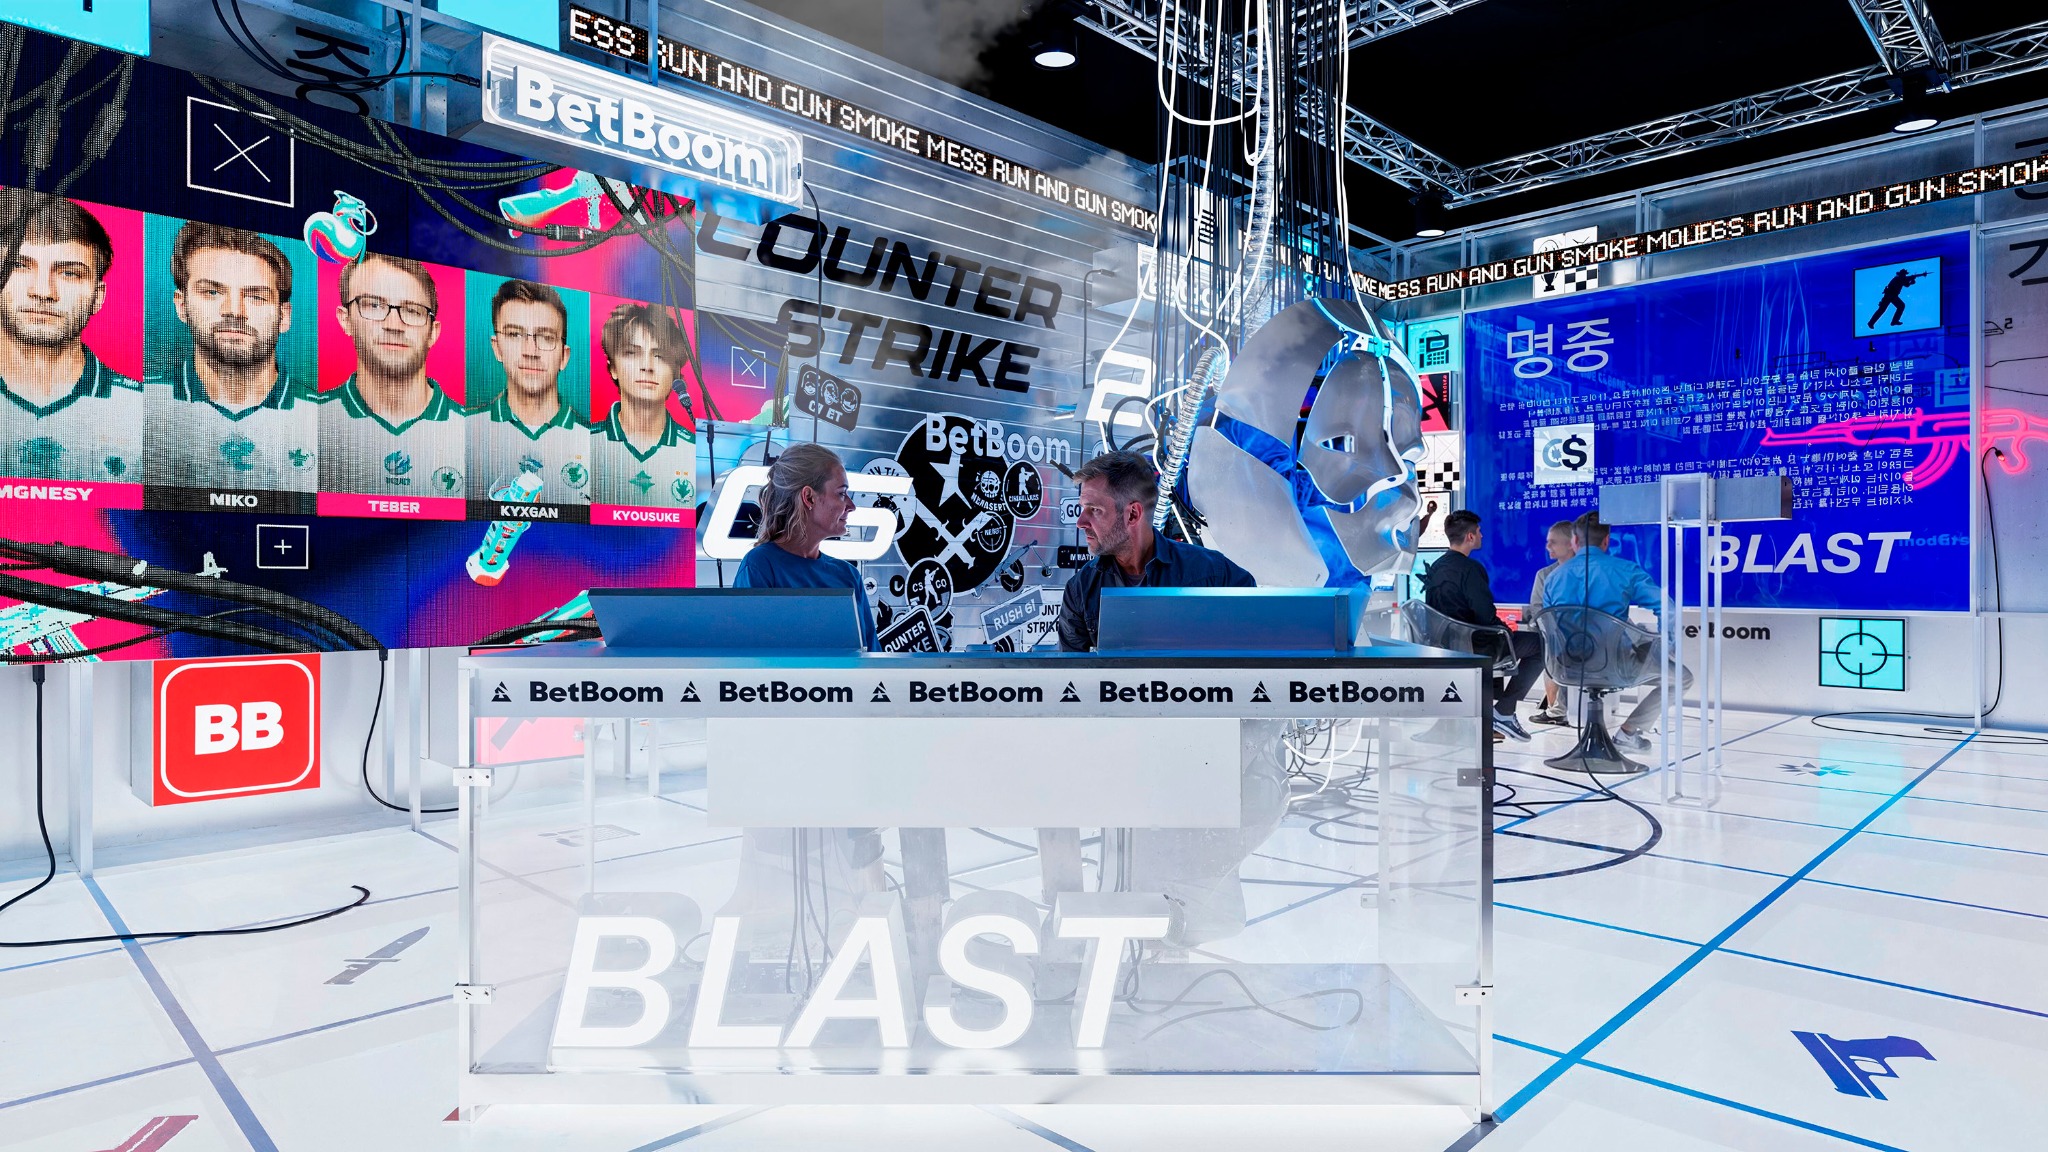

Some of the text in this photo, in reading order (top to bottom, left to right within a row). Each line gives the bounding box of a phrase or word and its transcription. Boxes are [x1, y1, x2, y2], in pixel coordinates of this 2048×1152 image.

[513, 65, 769, 189] BetBoom
[570, 9, 635, 56] ESS
[717, 61, 772, 103] AND
[782, 85, 831, 123] GUN
[840, 105, 919, 154] SMOKE
[927, 134, 986, 176] MESS
[992, 158, 1030, 191] RUN
[1035, 173, 1069, 204] AND
[1075, 187, 1107, 217] GUN
[1111, 200, 1157, 233] SMOK
[1379, 279, 1420, 300] MESS
[1427, 270, 1463, 293] RUN
[1469, 262, 1507, 286] AND
[1513, 252, 1554, 277] GUN
[1561, 237, 1639, 268] SMOKE
[1754, 204, 1807, 233] RUN
[1817, 191, 1873, 222] AND
[1885, 176, 1945, 209] GUN
[777, 299, 1041, 394] STRIKE
[1507, 318, 1615, 379] 명중
[926, 413, 1071, 465] BetBoom
[209, 493, 259, 508] NIKO
[367, 500, 421, 514] TEBER
[500, 505, 559, 519] KYXGAN
[612, 510, 681, 523] KYOUSUKE
[1707, 531, 1912, 574] BLAST
[912, 578, 947, 593] CS GO
[993, 605, 1023, 631] RUSH
[530, 681, 1425, 704] BetBoom BetBoom BetBoom BetBoom BetBoom
[194, 701, 285, 756] BB
[551, 913, 1170, 1049] BLAST
